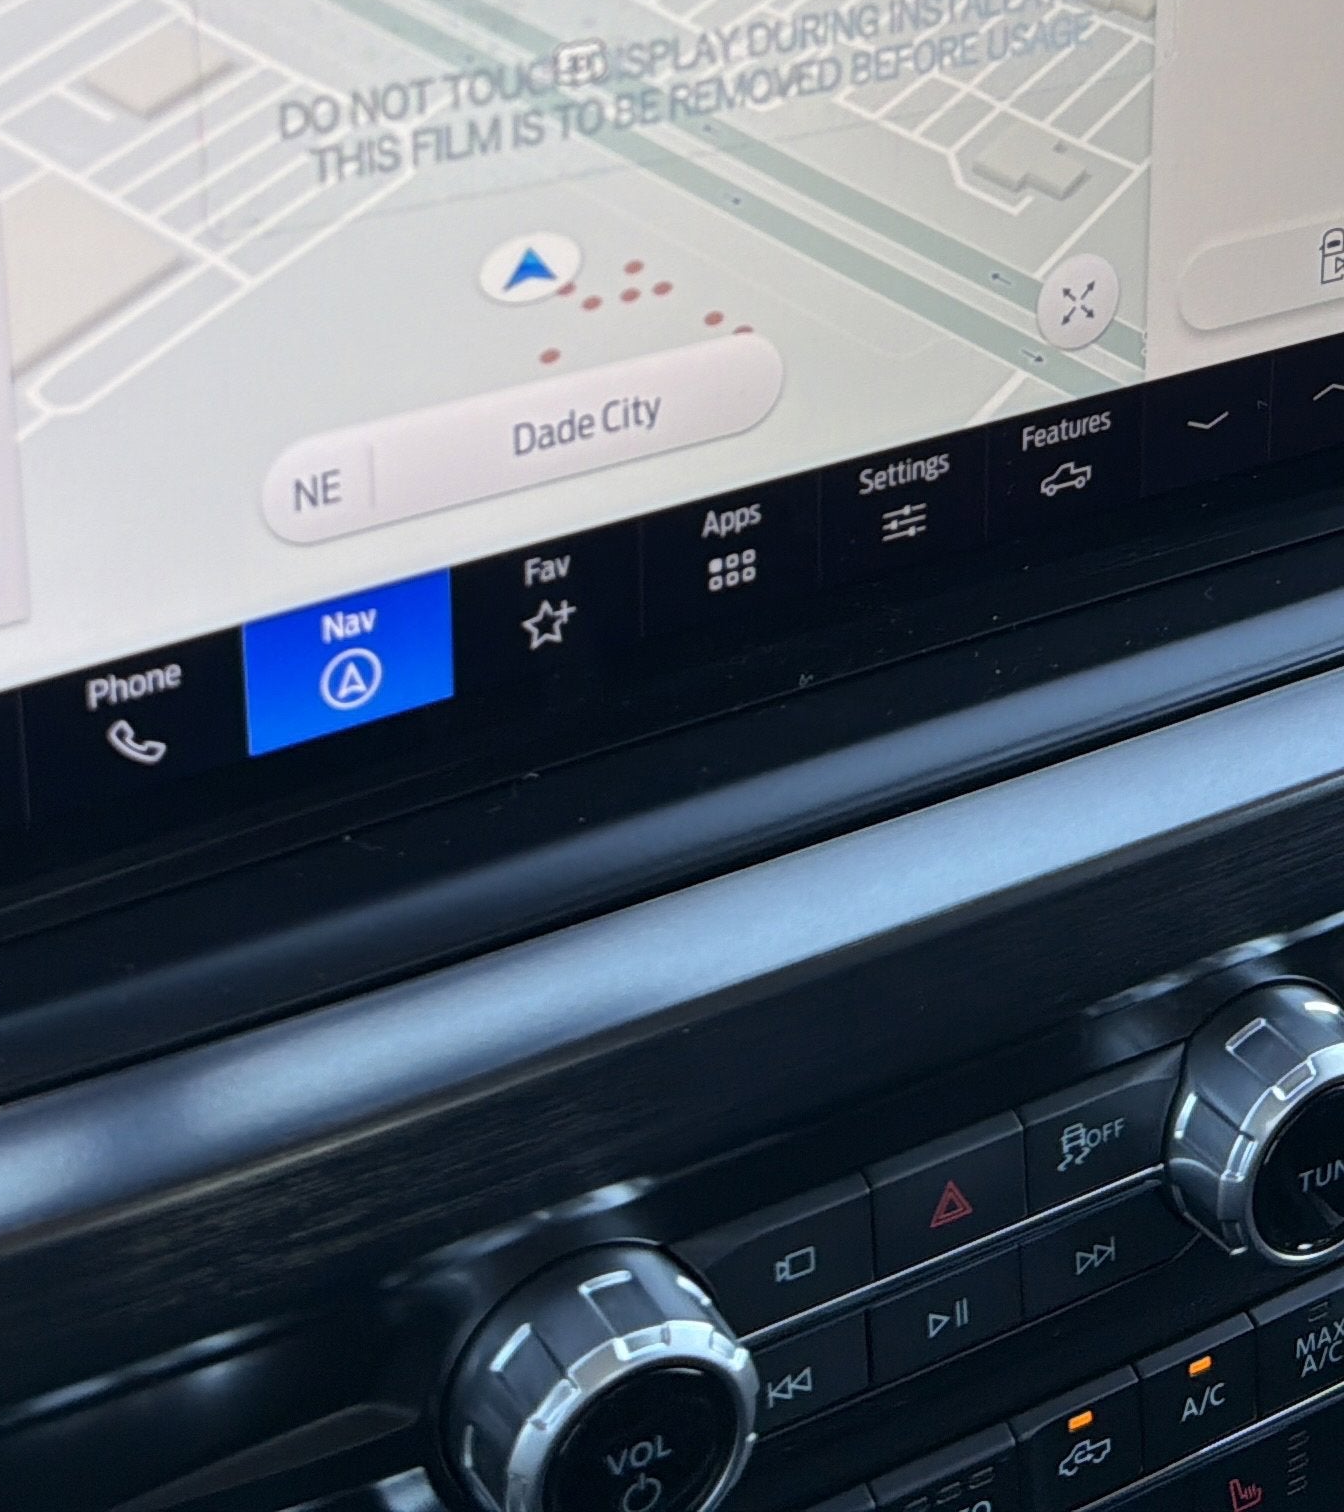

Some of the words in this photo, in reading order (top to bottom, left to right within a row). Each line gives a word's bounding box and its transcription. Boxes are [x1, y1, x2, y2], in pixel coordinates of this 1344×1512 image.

[278, 94, 342, 142] DO
[351, 80, 434, 131] NOT
[746, 2, 881, 61] DURING
[309, 131, 403, 185] THIS
[411, 113, 502, 169] FILM
[513, 109, 546, 151] IS
[556, 96, 608, 143] TO
[613, 85, 662, 132] BE
[668, 56, 843, 122] REMOVED
[850, 30, 981, 88] BEFORE
[986, 8, 1096, 65] USAGE
[512, 409, 594, 458] Dade
[600, 395, 662, 435] City
[1020, 409, 1112, 452] Features
[292, 468, 342, 514] NE
[858, 450, 950, 496] Settings
[702, 502, 762, 542] Apps
[523, 551, 571, 587] Fav
[321, 603, 378, 643] Nav
[86, 659, 183, 711] Phone
[1085, 1117, 1127, 1148] OFF
[1300, 1339, 1344, 1379] A/C
[1180, 1382, 1226, 1423] A/C
[606, 1434, 672, 1476] VOL
